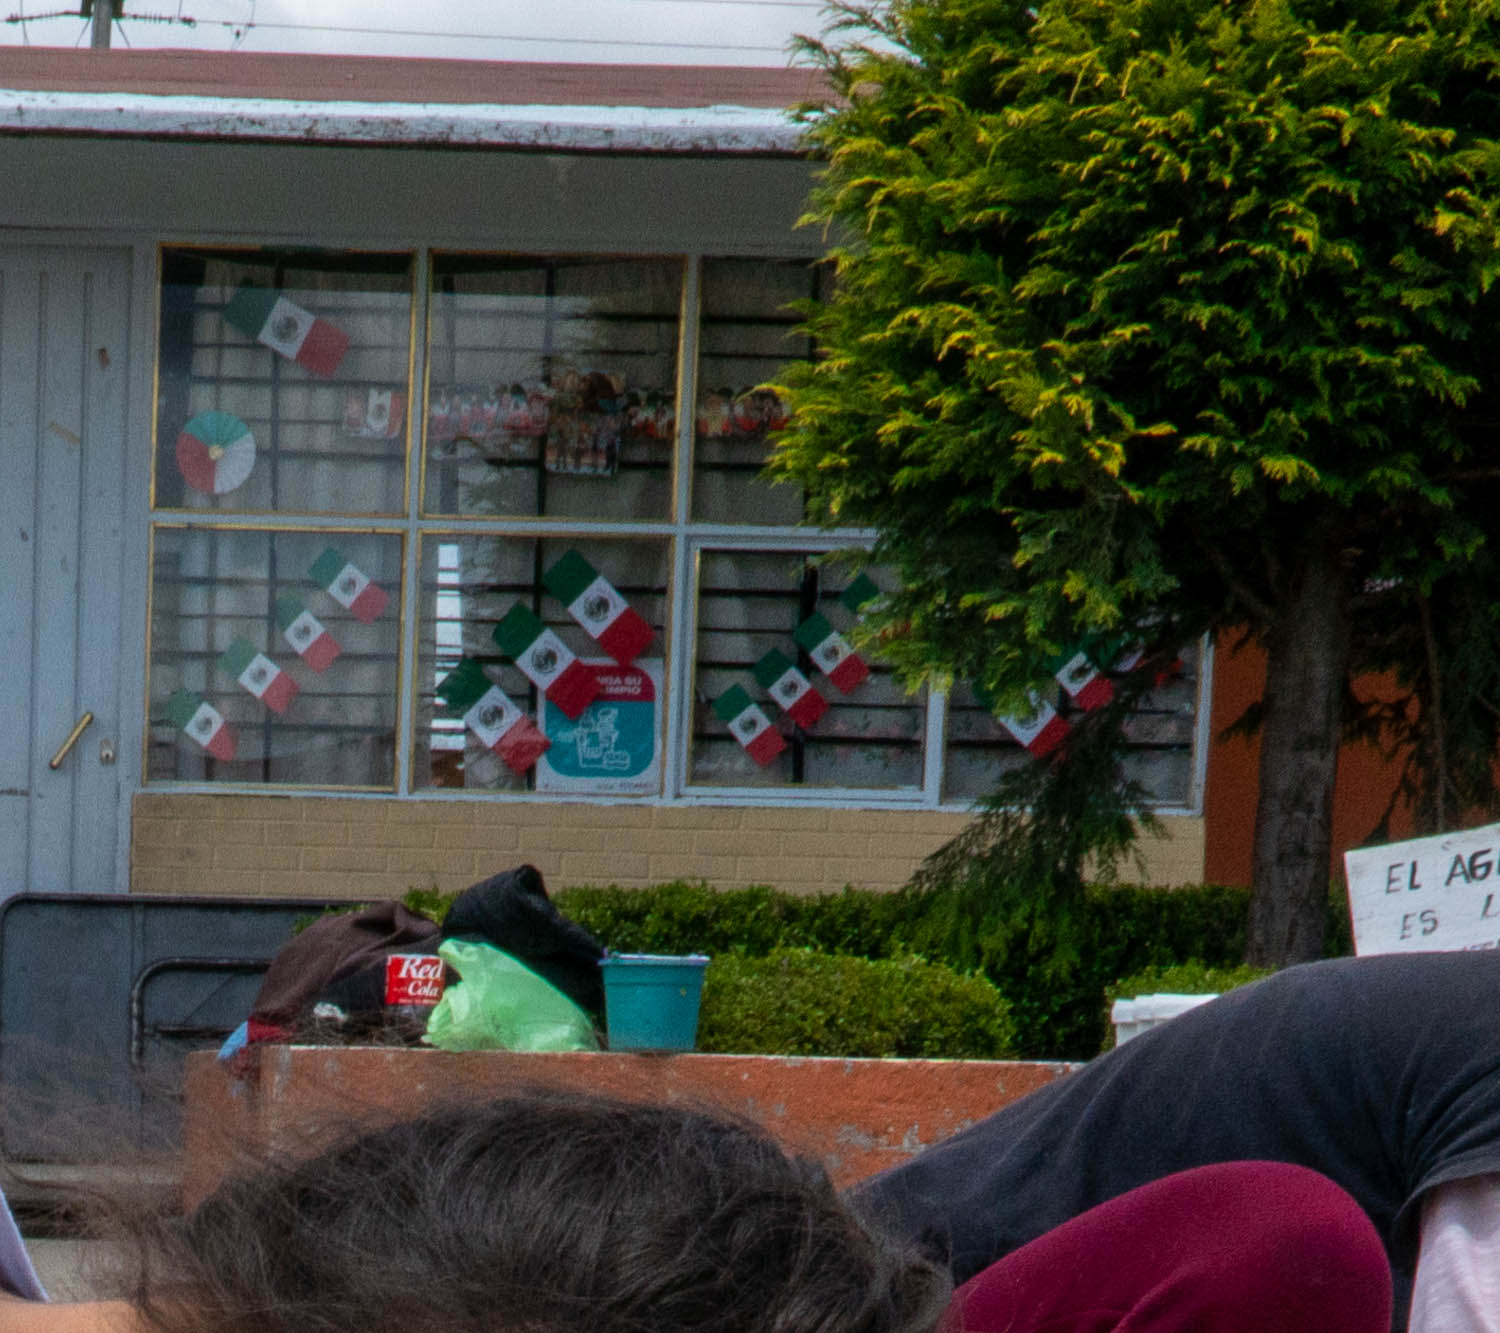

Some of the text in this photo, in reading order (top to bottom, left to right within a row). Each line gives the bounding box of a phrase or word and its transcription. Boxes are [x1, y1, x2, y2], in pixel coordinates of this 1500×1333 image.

[1384, 858, 1422, 895] EL
[1399, 909, 1440, 940] ES
[397, 957, 444, 979] Red
[407, 980, 440, 997] Cola
